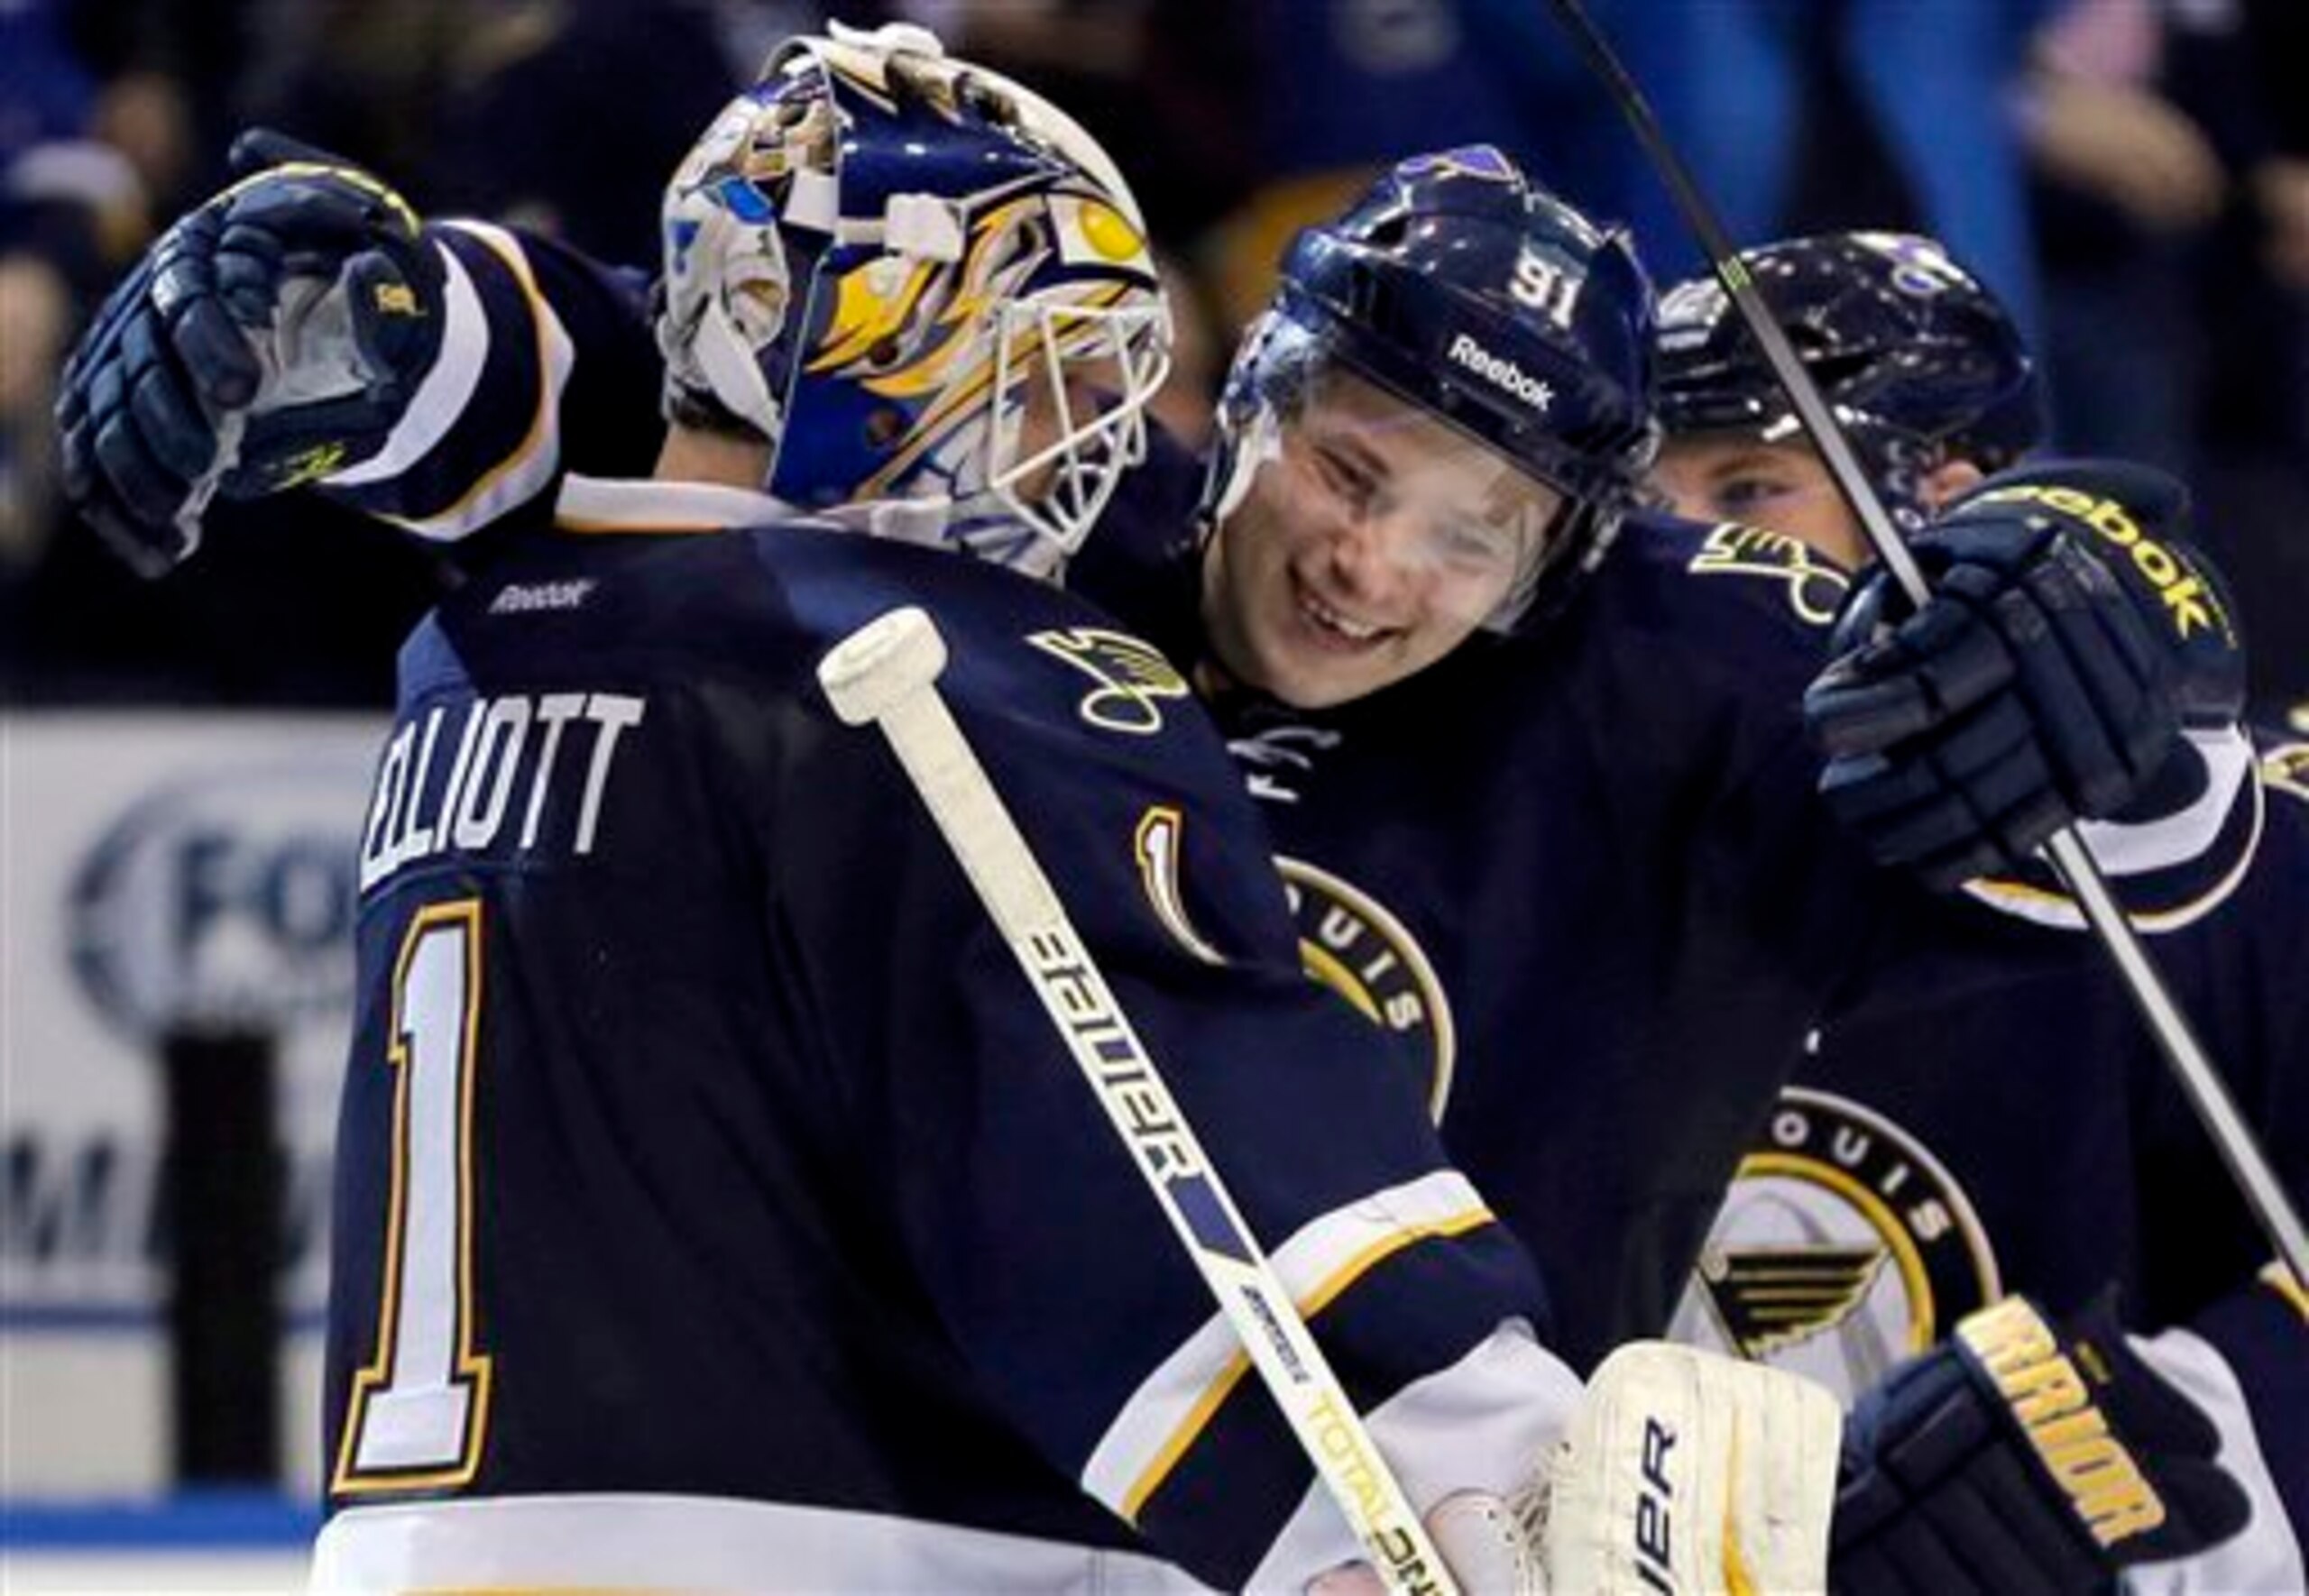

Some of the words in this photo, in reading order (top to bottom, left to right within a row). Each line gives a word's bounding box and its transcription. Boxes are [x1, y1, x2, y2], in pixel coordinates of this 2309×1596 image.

[1508, 248, 1585, 330] 91
[1448, 332, 1557, 413] Reebok
[331, 898, 493, 1497] 1
[1771, 1110, 1952, 1242] OUIS
